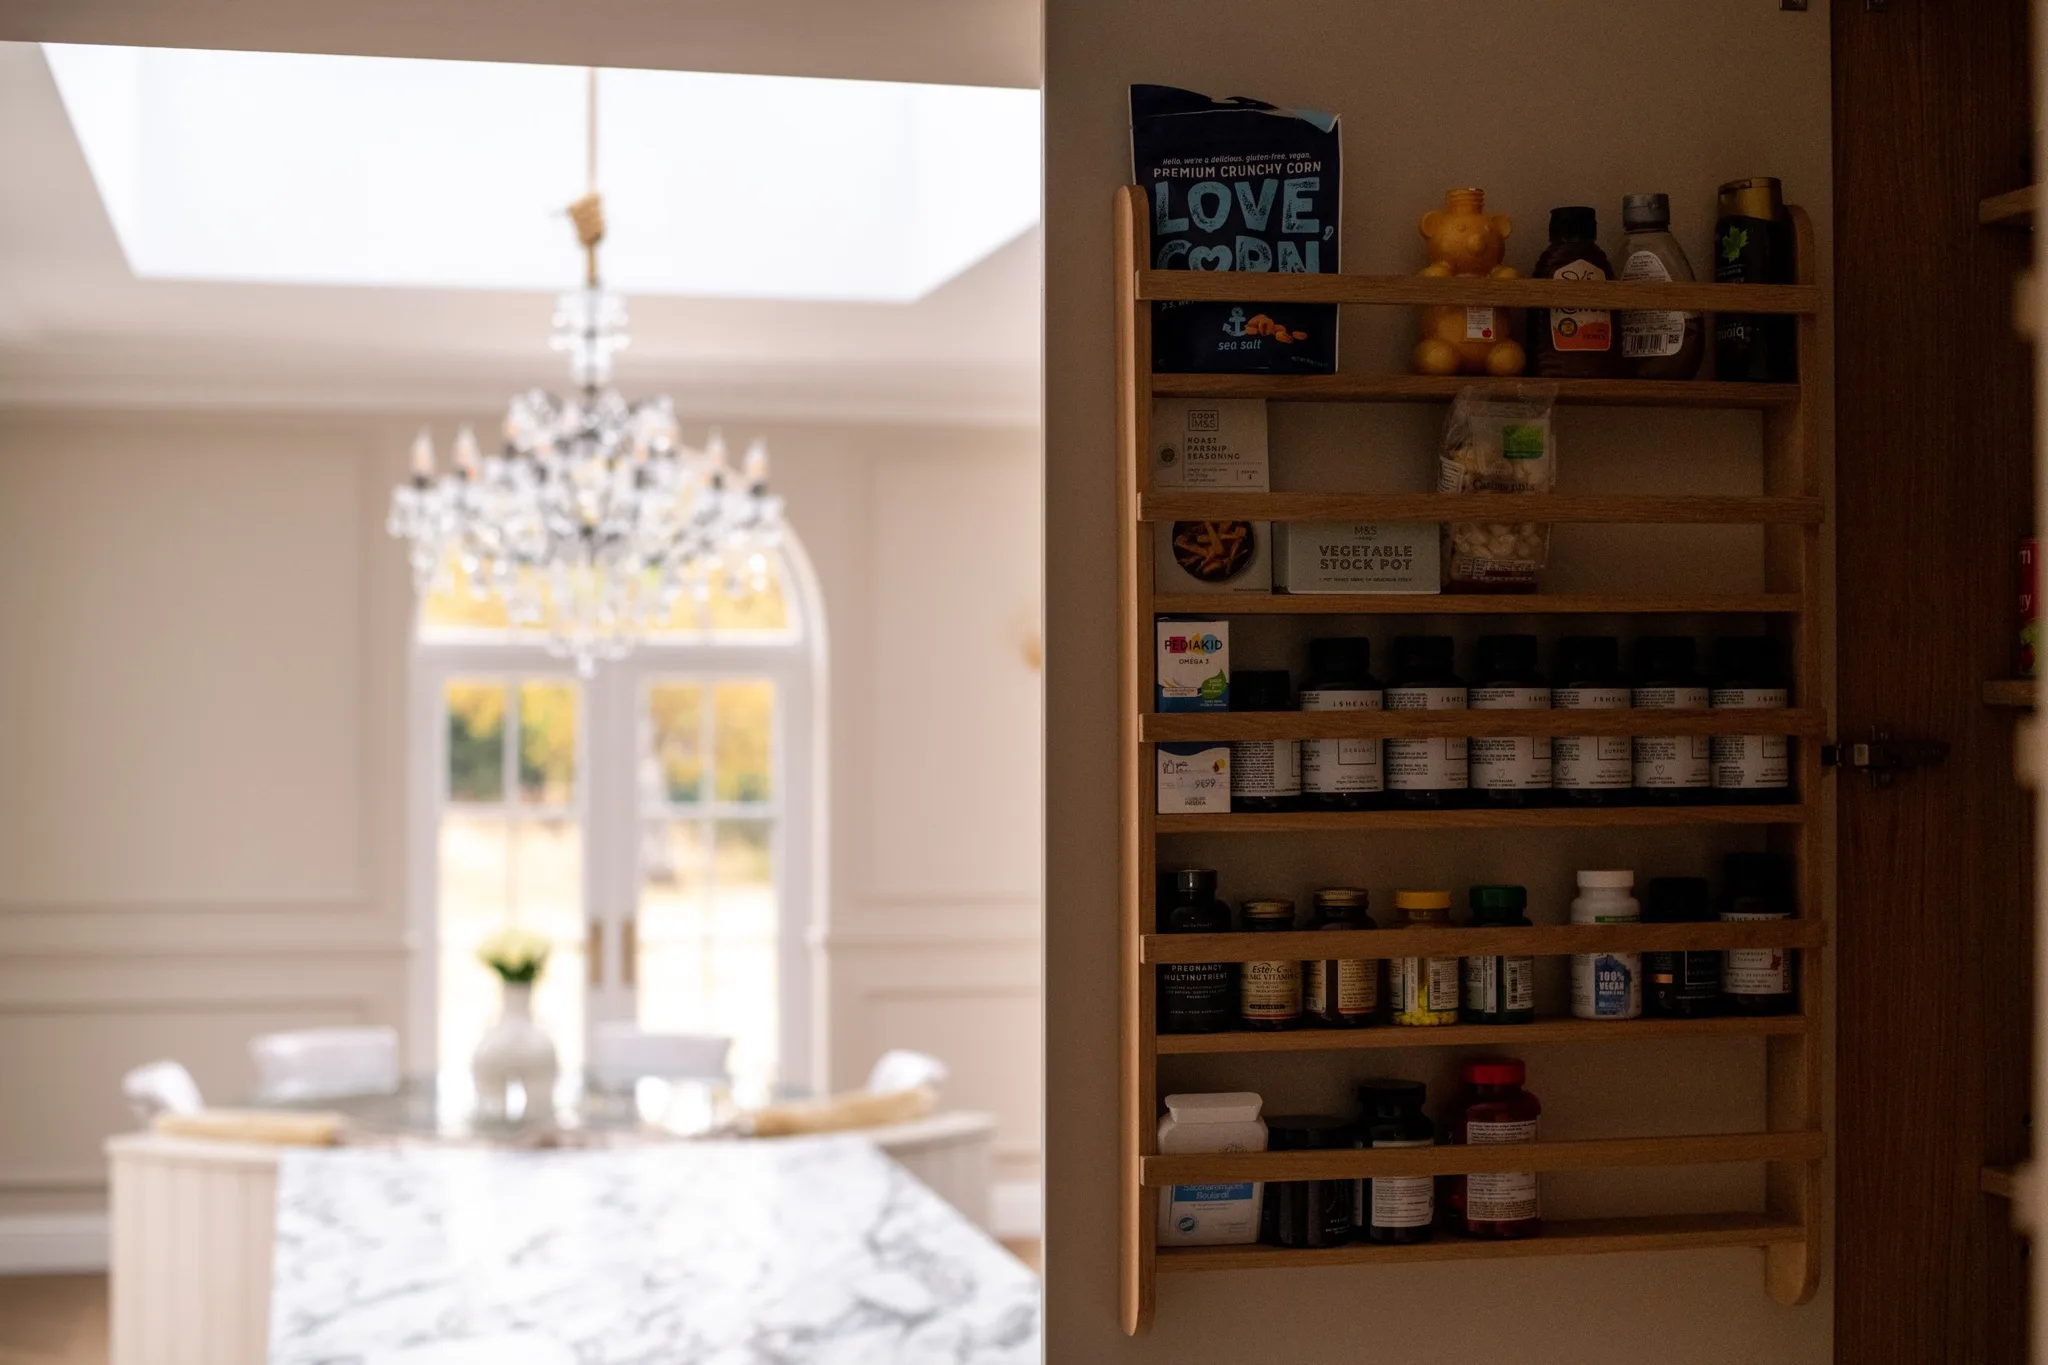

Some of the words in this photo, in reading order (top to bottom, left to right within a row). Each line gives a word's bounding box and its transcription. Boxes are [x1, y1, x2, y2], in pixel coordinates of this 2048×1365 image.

[1162, 157, 1182, 165] Hello,
[1153, 167, 1216, 178] PREMIUM
[1220, 163, 1282, 177] CRUNCHY
[1286, 161, 1322, 175] CORN
[1155, 177, 1334, 241] LOVE,
[1217, 341, 1237, 351] sea
[1240, 339, 1262, 350] salt
[1194, 419, 1216, 428] M&S
[1354, 526, 1377, 535] M&S
[1319, 545, 1413, 557] VEGETABLE
[1320, 558, 1374, 570] STOCK
[1379, 558, 1412, 570] POT
[1164, 639, 1223, 651] PEDIAKID
[1178, 657, 1203, 665] OMÉGA
[1171, 964, 1223, 972] PREGNANCY
[1252, 964, 1284, 974] Ester-C
[1164, 972, 1228, 981] MULTINUTRIENT
[1599, 971, 1625, 982] 100%
[1599, 982, 1625, 990] VEGAN
